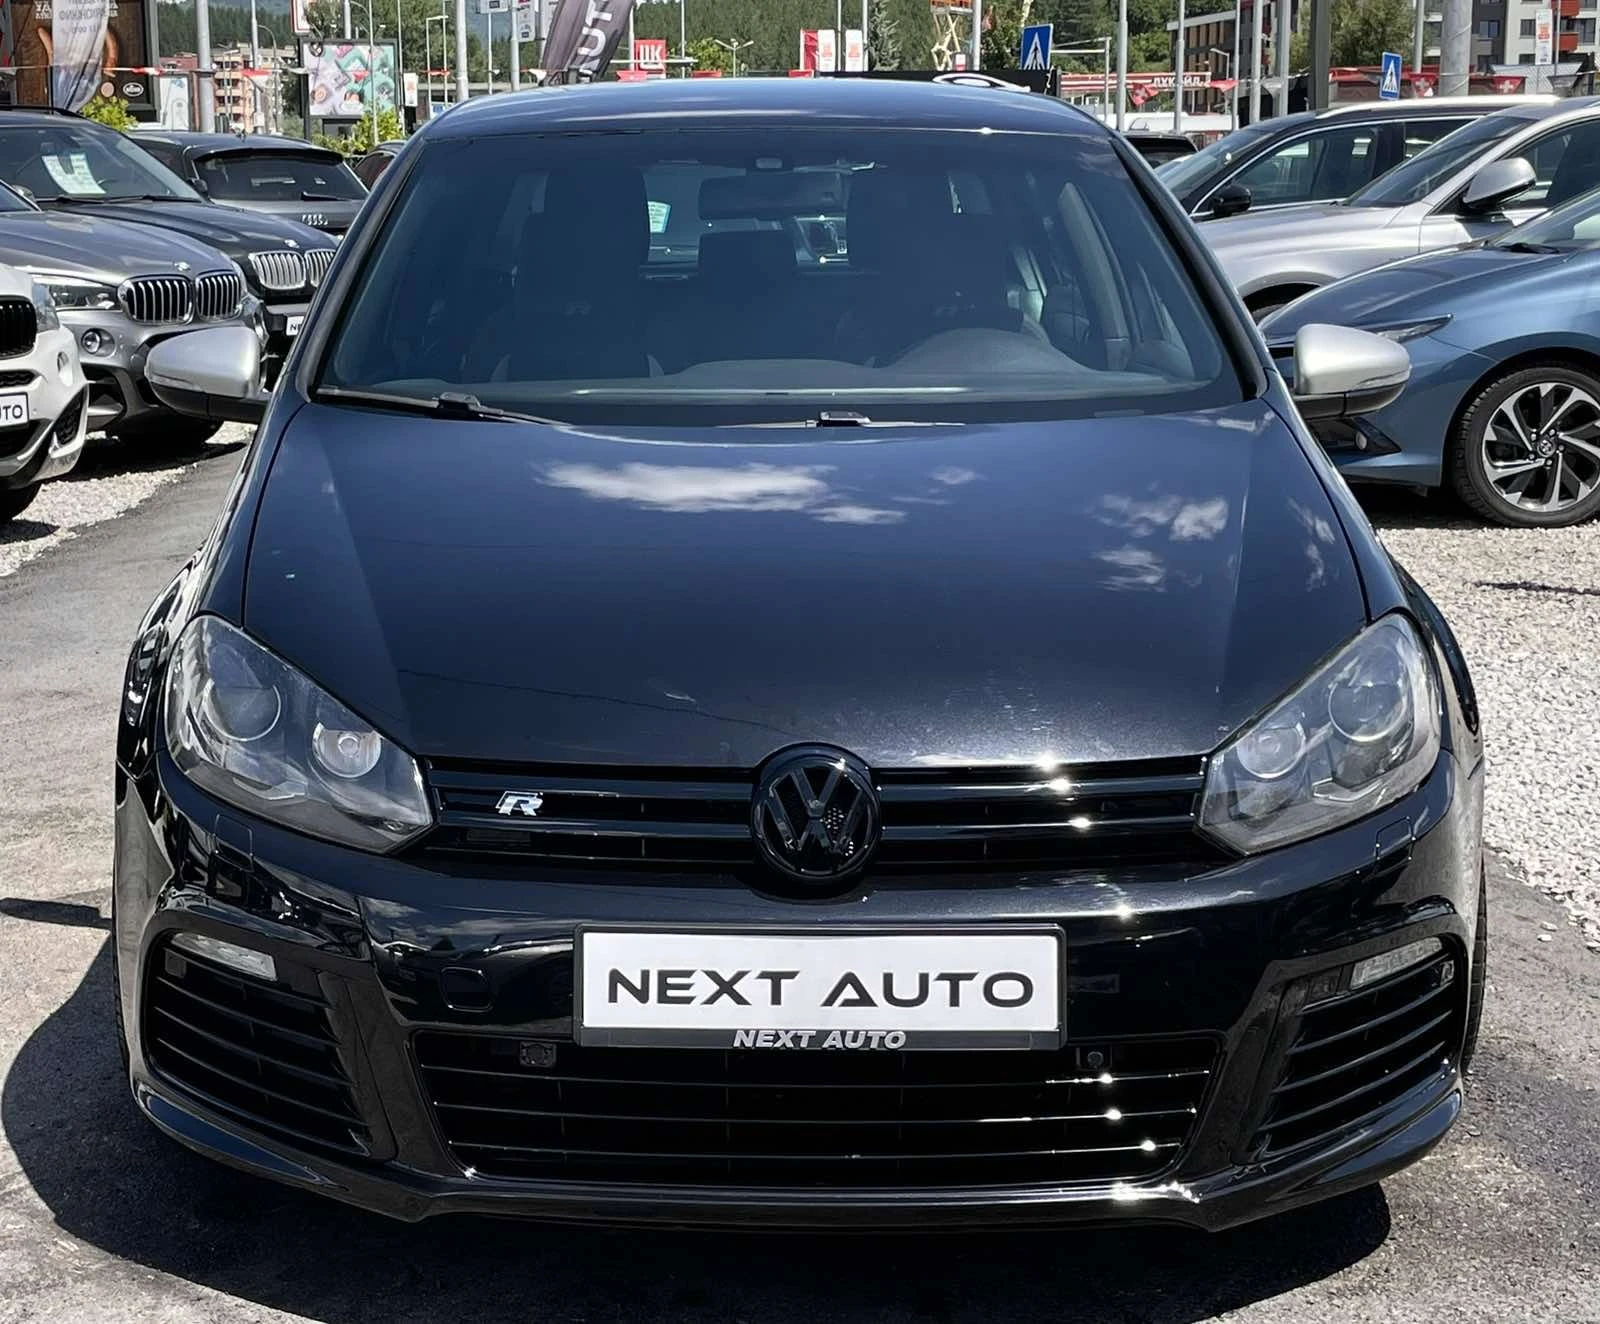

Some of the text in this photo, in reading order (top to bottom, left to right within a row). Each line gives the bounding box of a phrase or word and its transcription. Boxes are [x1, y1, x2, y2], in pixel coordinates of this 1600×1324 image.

[495, 790, 543, 816] R
[608, 967, 1034, 1009] NEXT AUTO
[733, 1029, 907, 1049] NEXT AUTO
